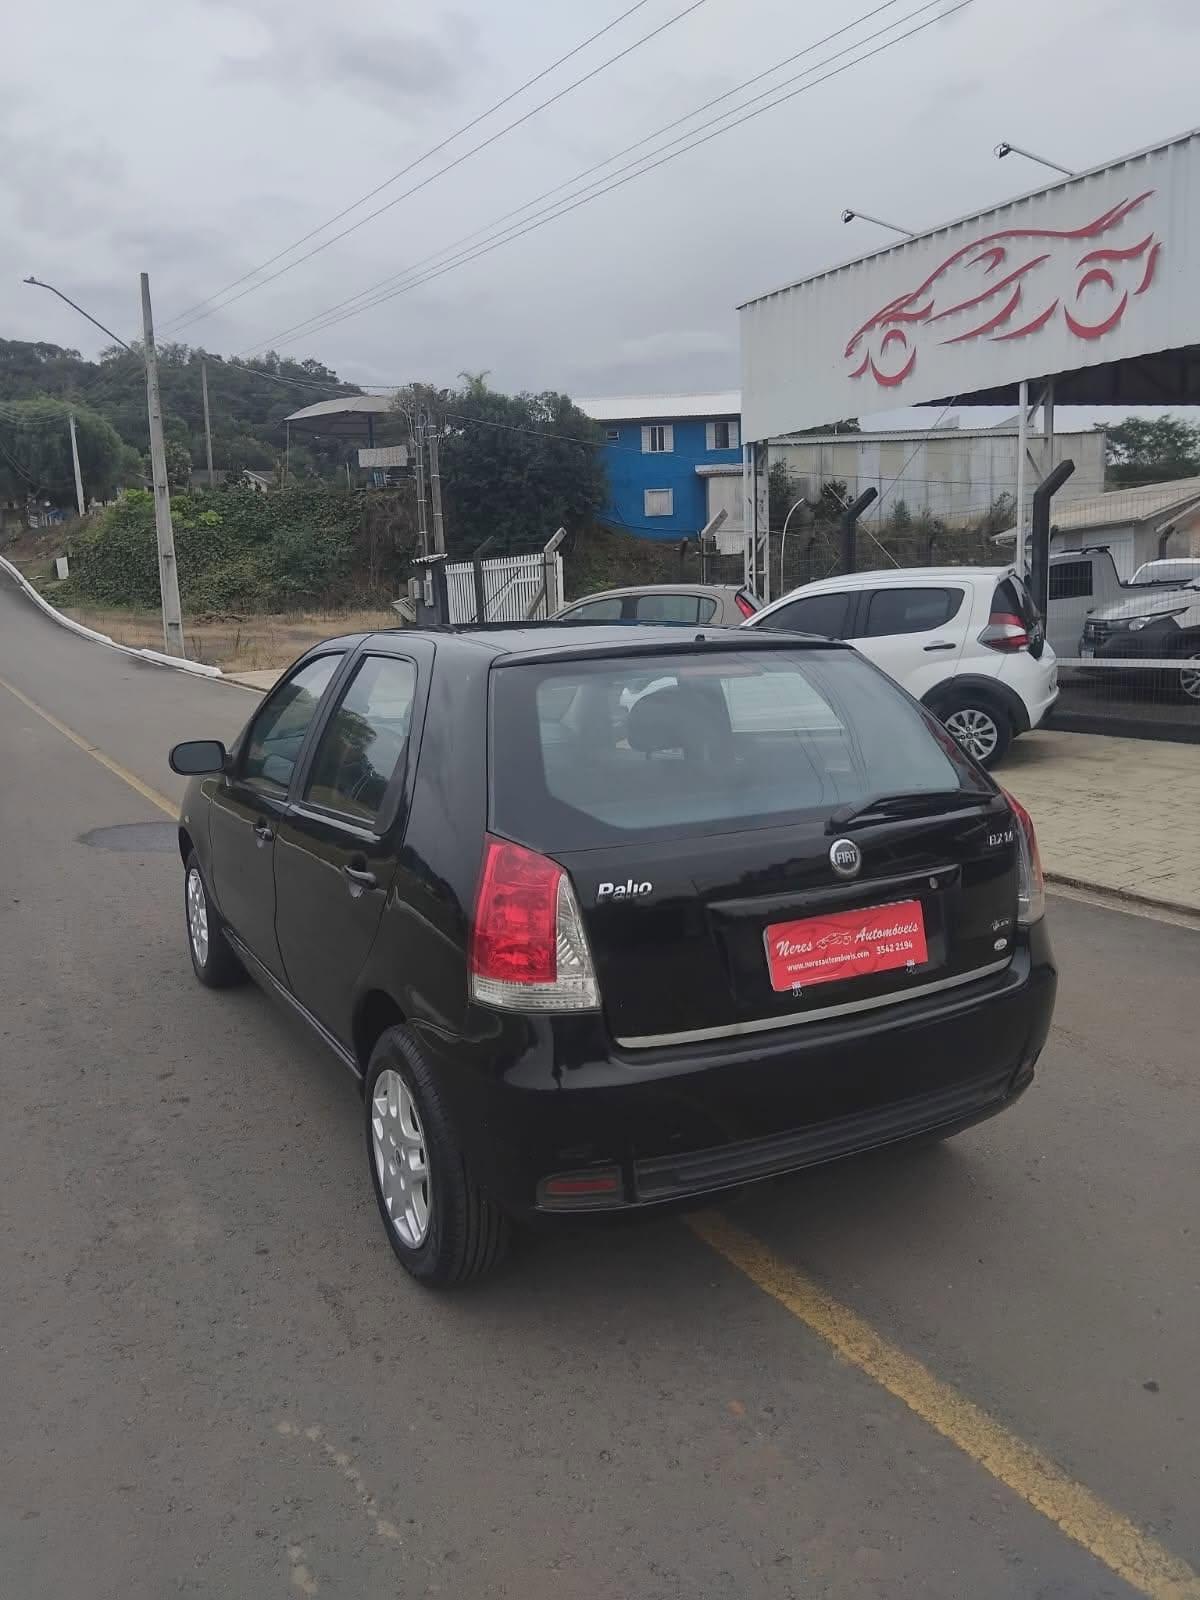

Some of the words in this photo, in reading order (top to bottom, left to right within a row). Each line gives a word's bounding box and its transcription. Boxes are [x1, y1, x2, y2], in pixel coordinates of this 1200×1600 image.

[836, 850, 856, 864] FIAT
[597, 879, 653, 900] Palio
[776, 941, 812, 956] Neres
[854, 922, 919, 943] Automóveis
[876, 943, 895, 955] 3542
